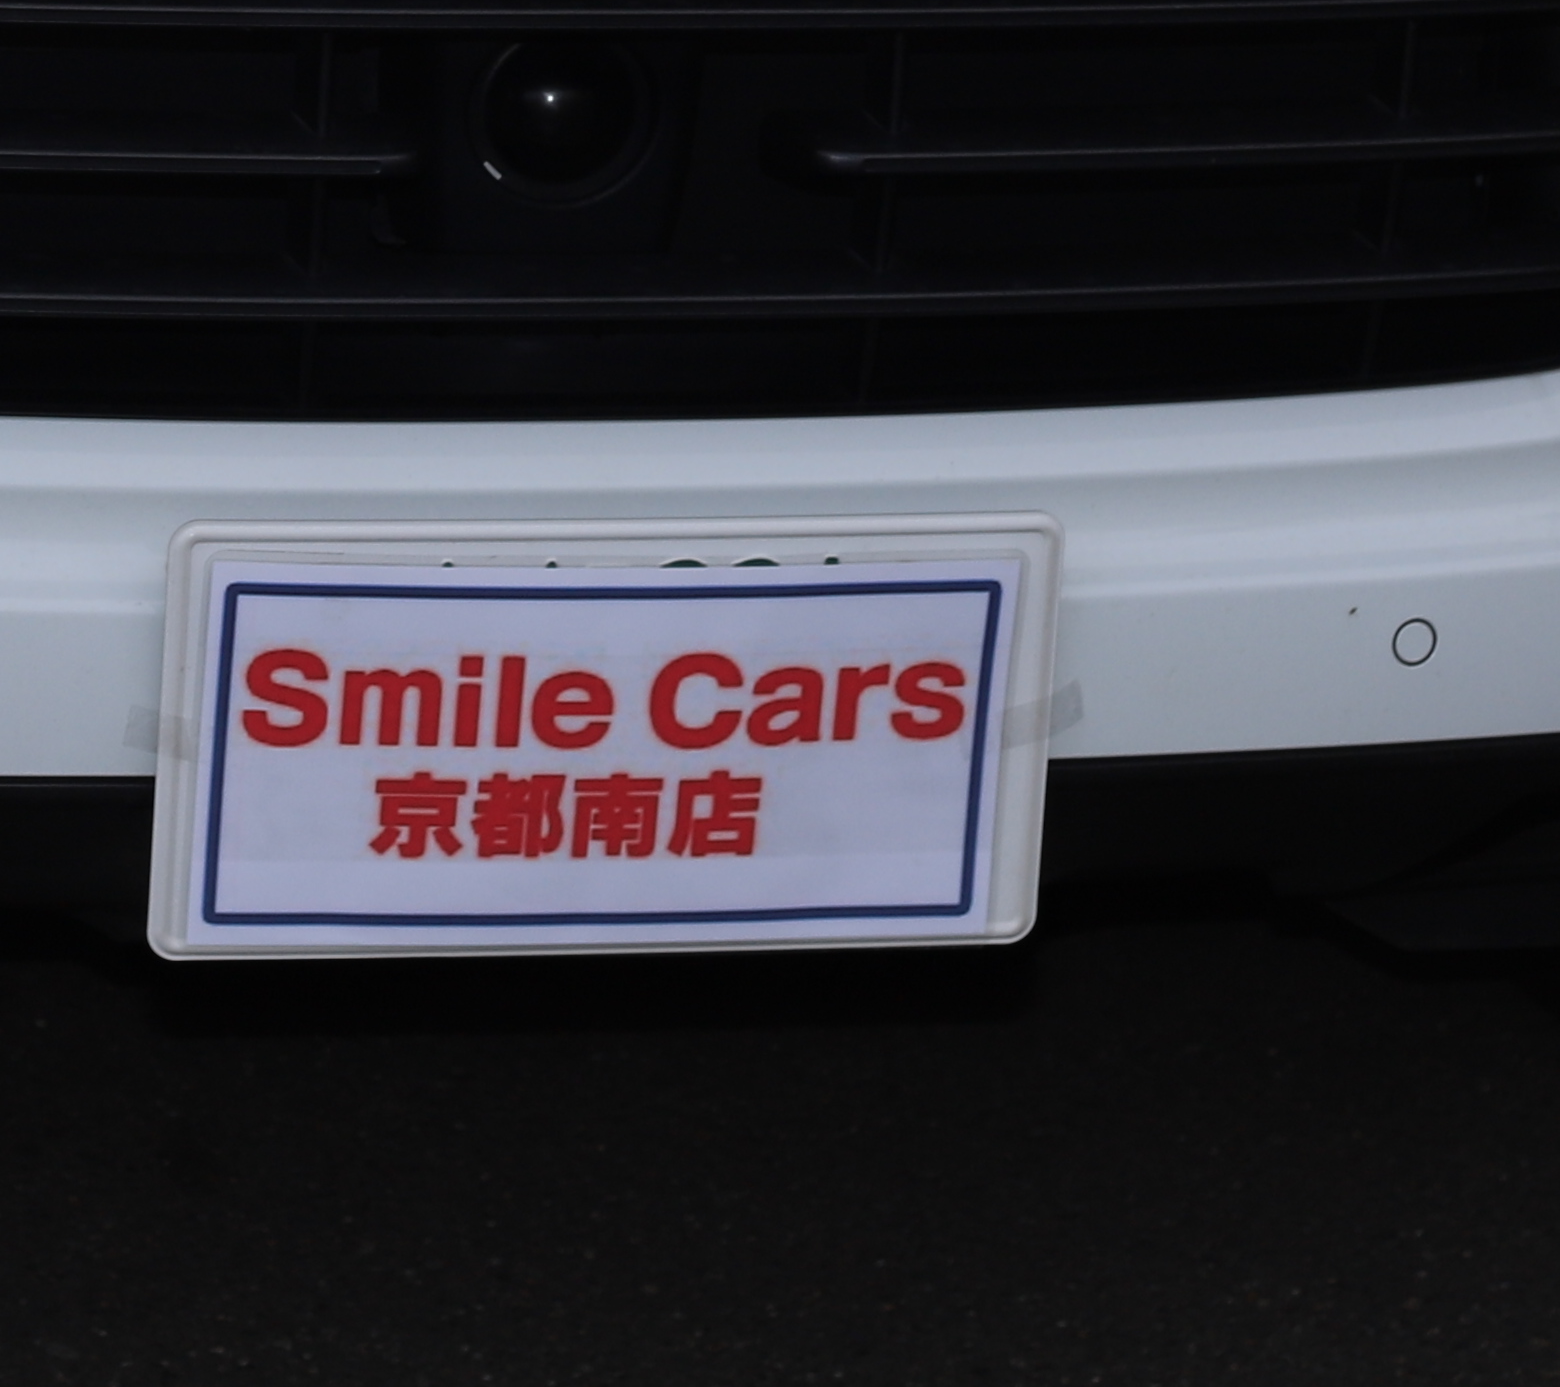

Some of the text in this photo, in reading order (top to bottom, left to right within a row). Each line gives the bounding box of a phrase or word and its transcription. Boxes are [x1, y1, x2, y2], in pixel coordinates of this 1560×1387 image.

[240, 646, 967, 751] Smile Cars
[368, 769, 764, 860] 京都南店
